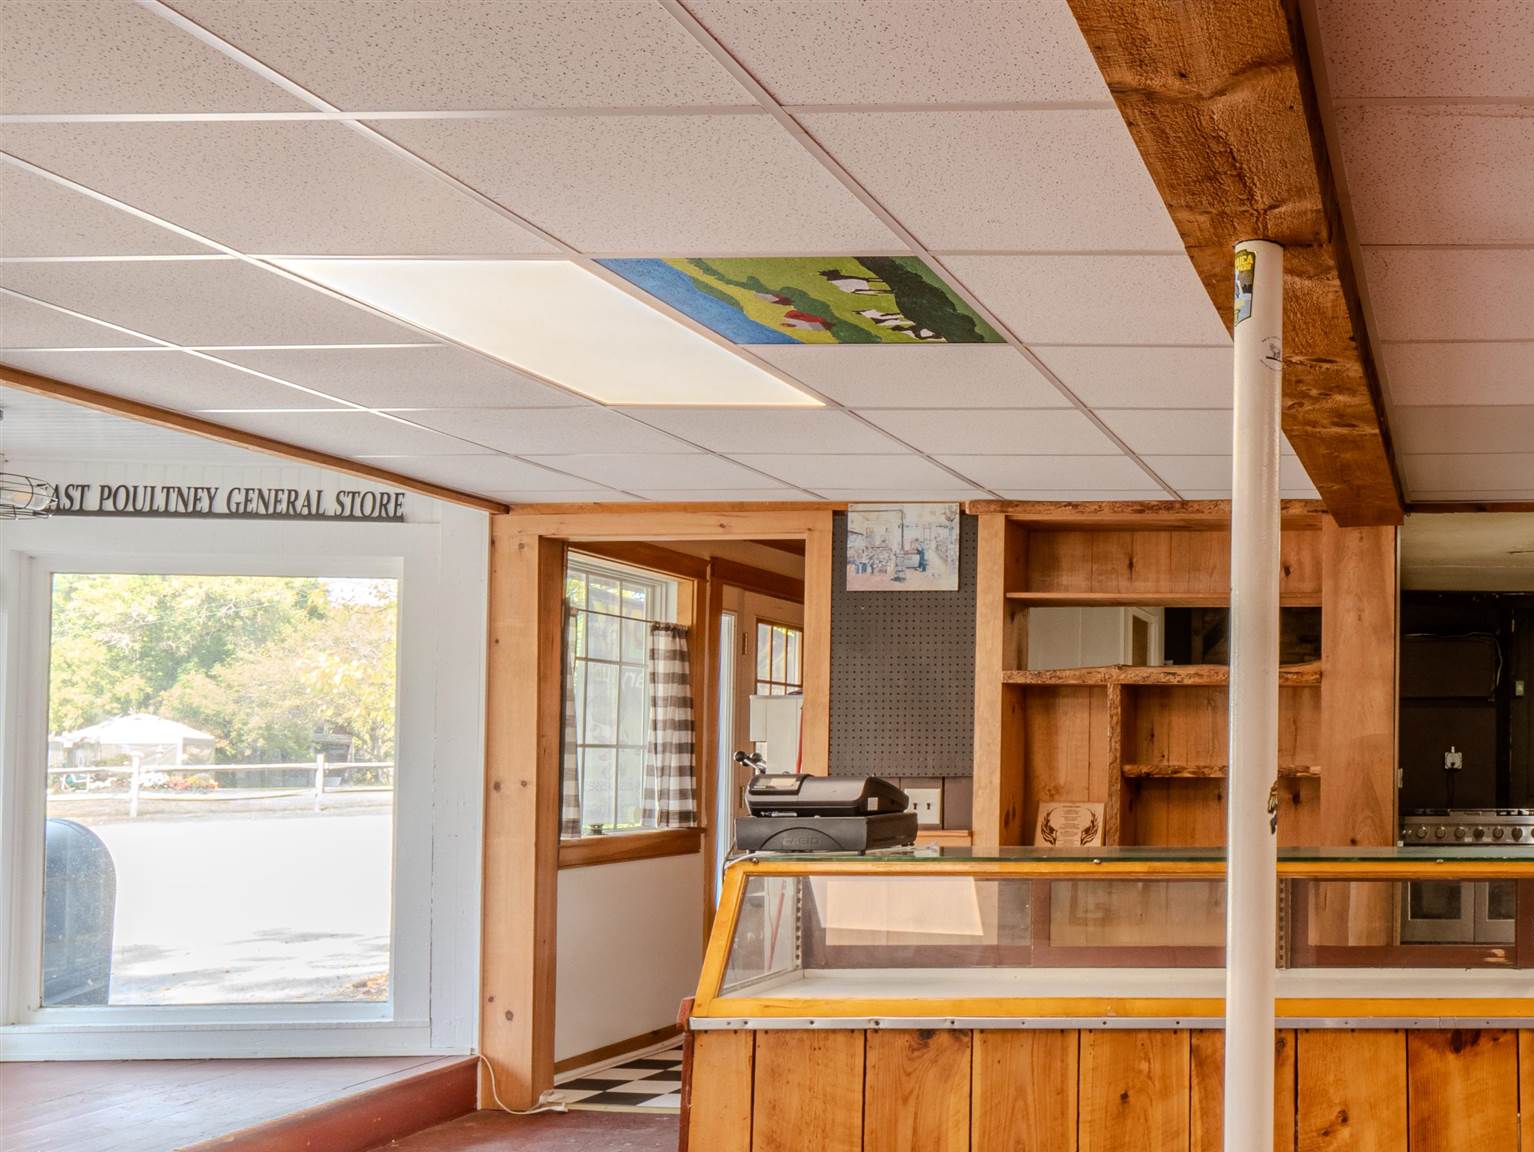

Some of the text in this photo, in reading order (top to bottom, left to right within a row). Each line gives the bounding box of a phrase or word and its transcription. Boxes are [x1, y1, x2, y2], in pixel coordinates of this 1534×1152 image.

[36, 483, 406, 518] AST POULTNEY GENERAL STORE
